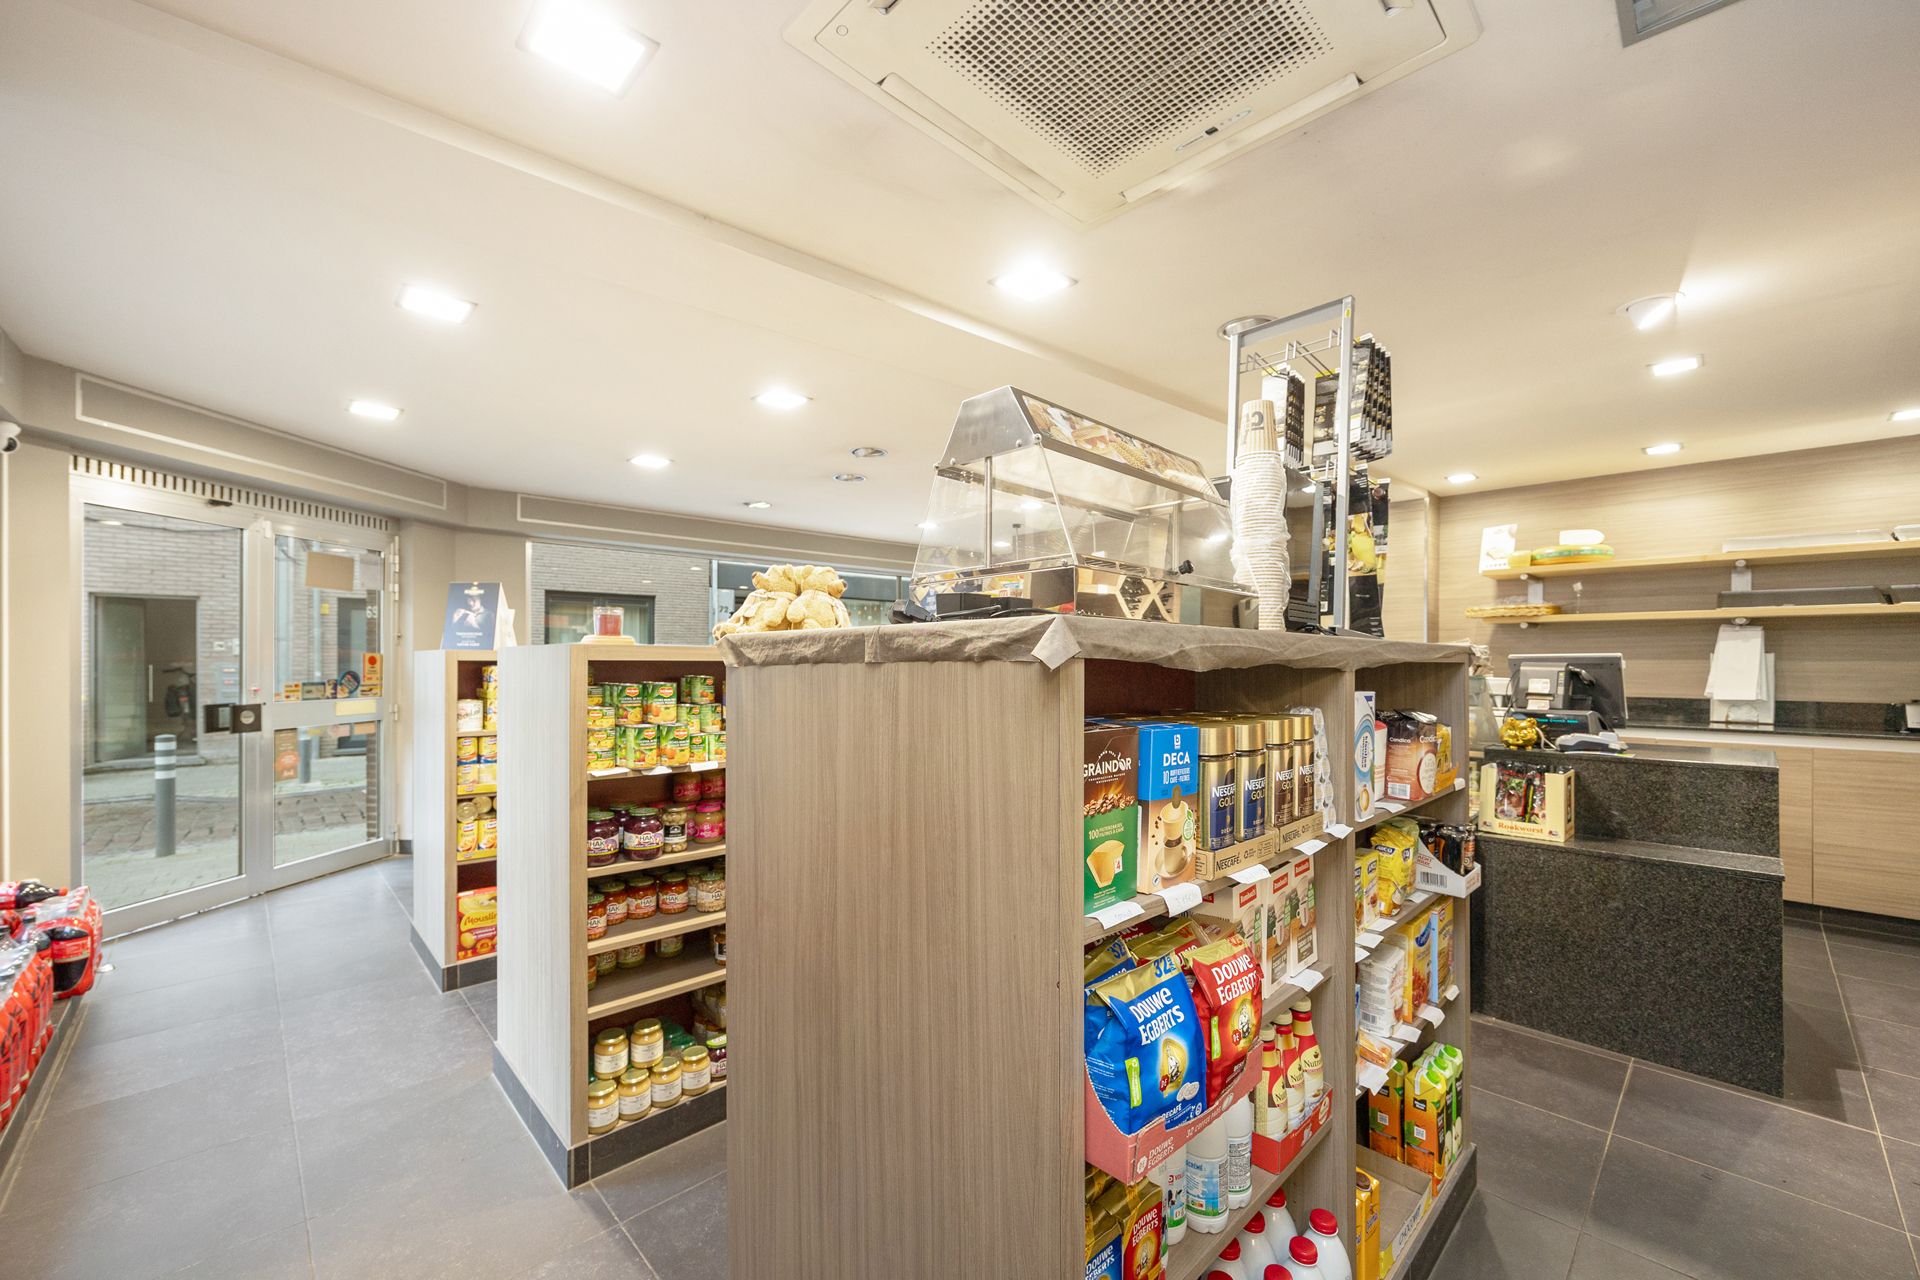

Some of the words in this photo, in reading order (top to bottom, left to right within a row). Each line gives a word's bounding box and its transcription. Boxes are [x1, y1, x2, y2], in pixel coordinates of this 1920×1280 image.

[1163, 752, 1190, 766] DECA
[590, 840, 604, 848] HAK
[1089, 829, 1100, 840] 100
[1154, 955, 1172, 978] 32
[1138, 1005, 1184, 1046] EGBERTS
[1148, 1144, 1174, 1168] EGBERTS
[1132, 1218, 1158, 1247] EGBERTS
